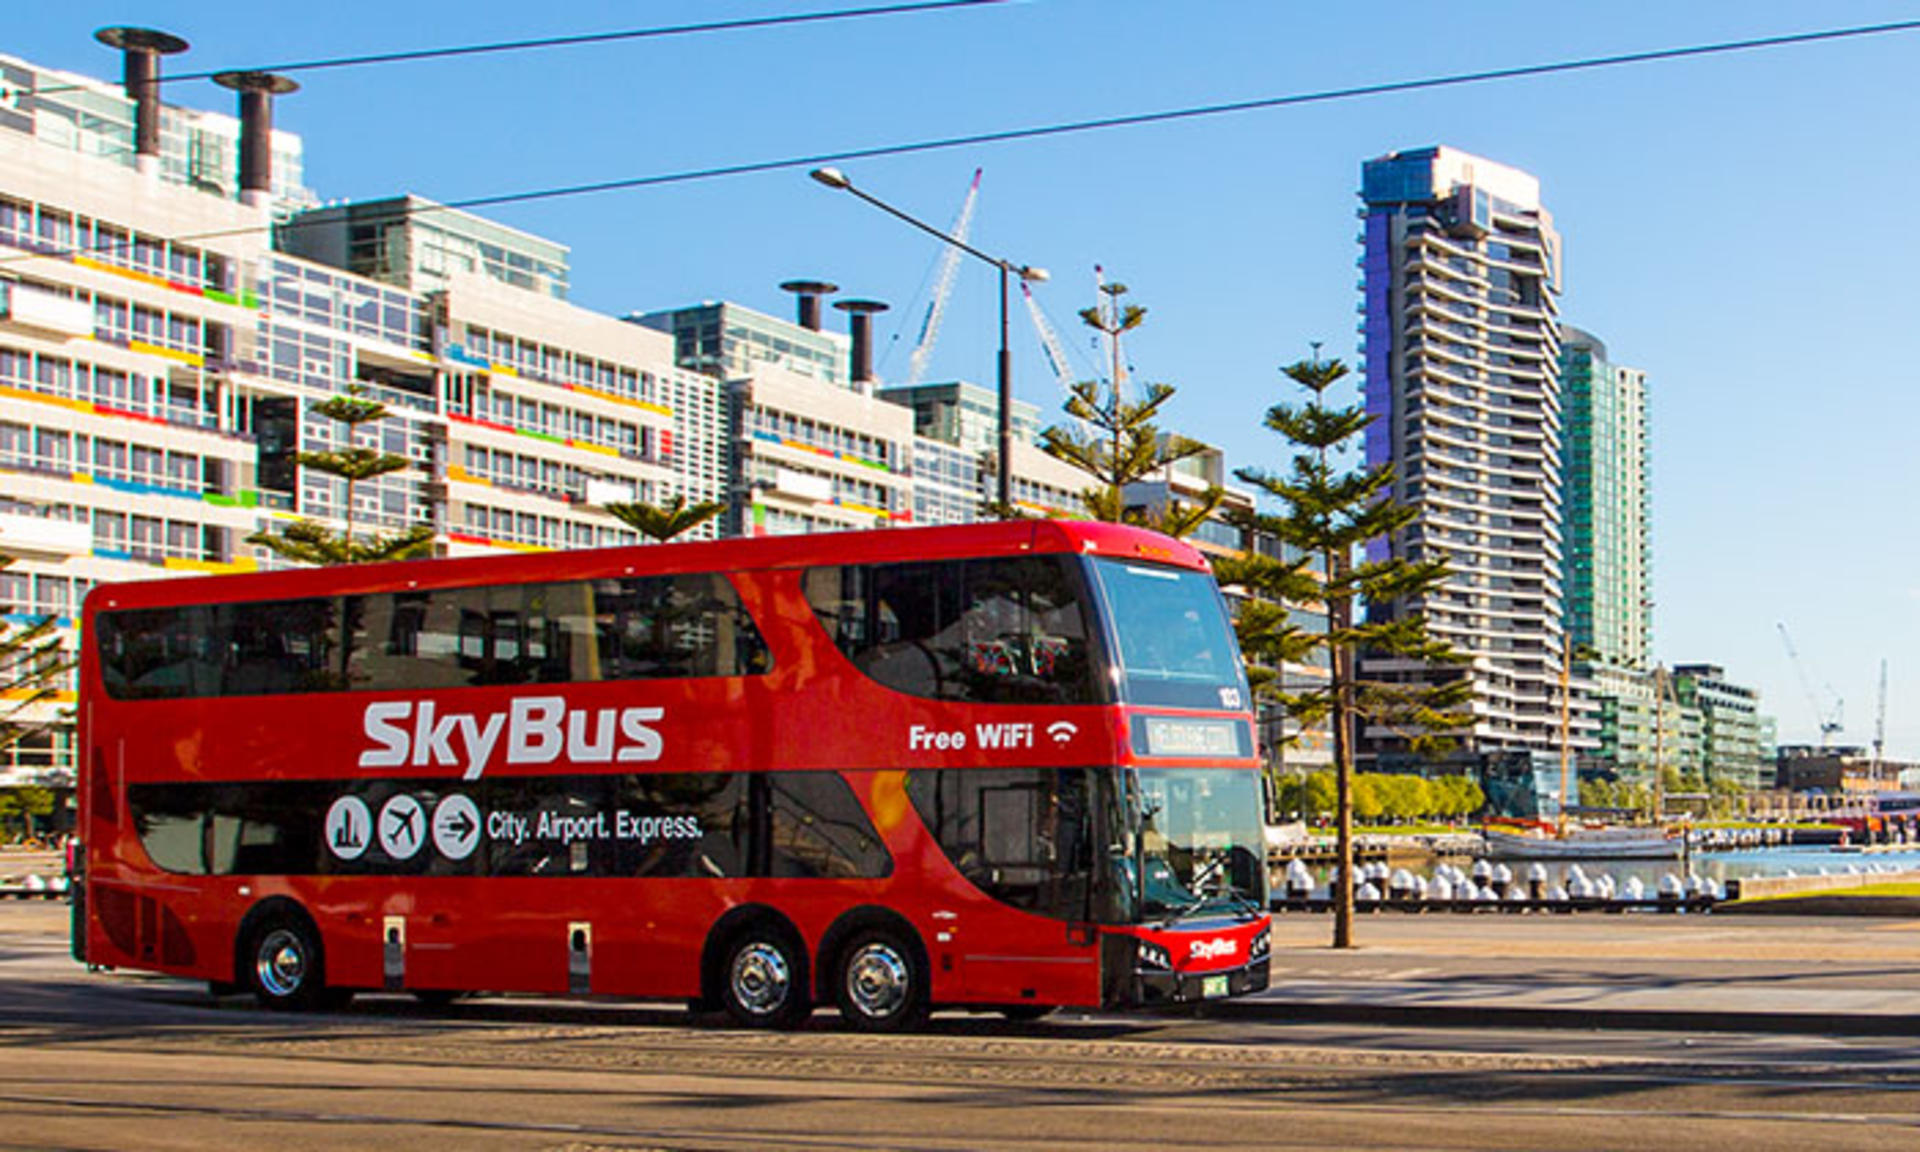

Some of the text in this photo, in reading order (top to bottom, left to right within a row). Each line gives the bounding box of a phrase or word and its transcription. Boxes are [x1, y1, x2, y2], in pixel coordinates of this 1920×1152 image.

[358, 696, 665, 780] SkyBus
[909, 723, 1034, 750] Free WiFi
[486, 809, 703, 846] City. Airport. Express.
